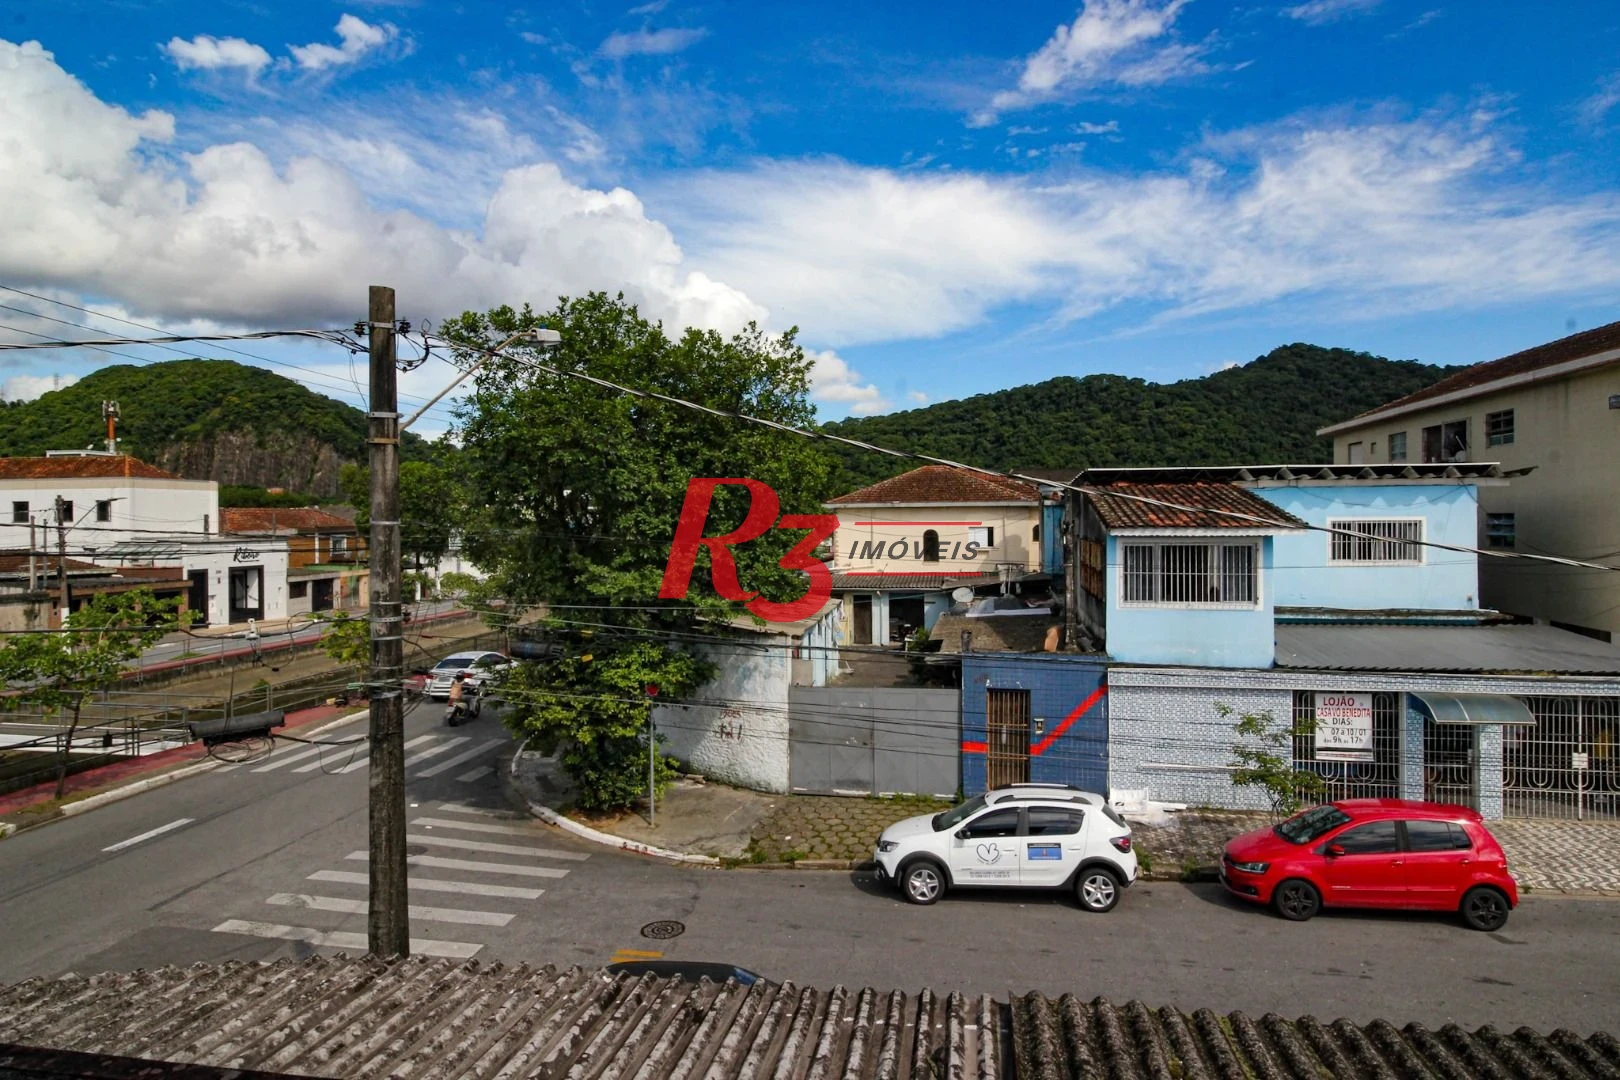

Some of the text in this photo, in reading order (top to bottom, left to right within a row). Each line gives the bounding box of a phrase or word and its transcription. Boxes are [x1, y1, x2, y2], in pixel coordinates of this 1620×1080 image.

[1323, 696, 1355, 707] LOJÃO
[1317, 707, 1331, 717] CASA
[1342, 707, 1372, 718] BENEDITA
